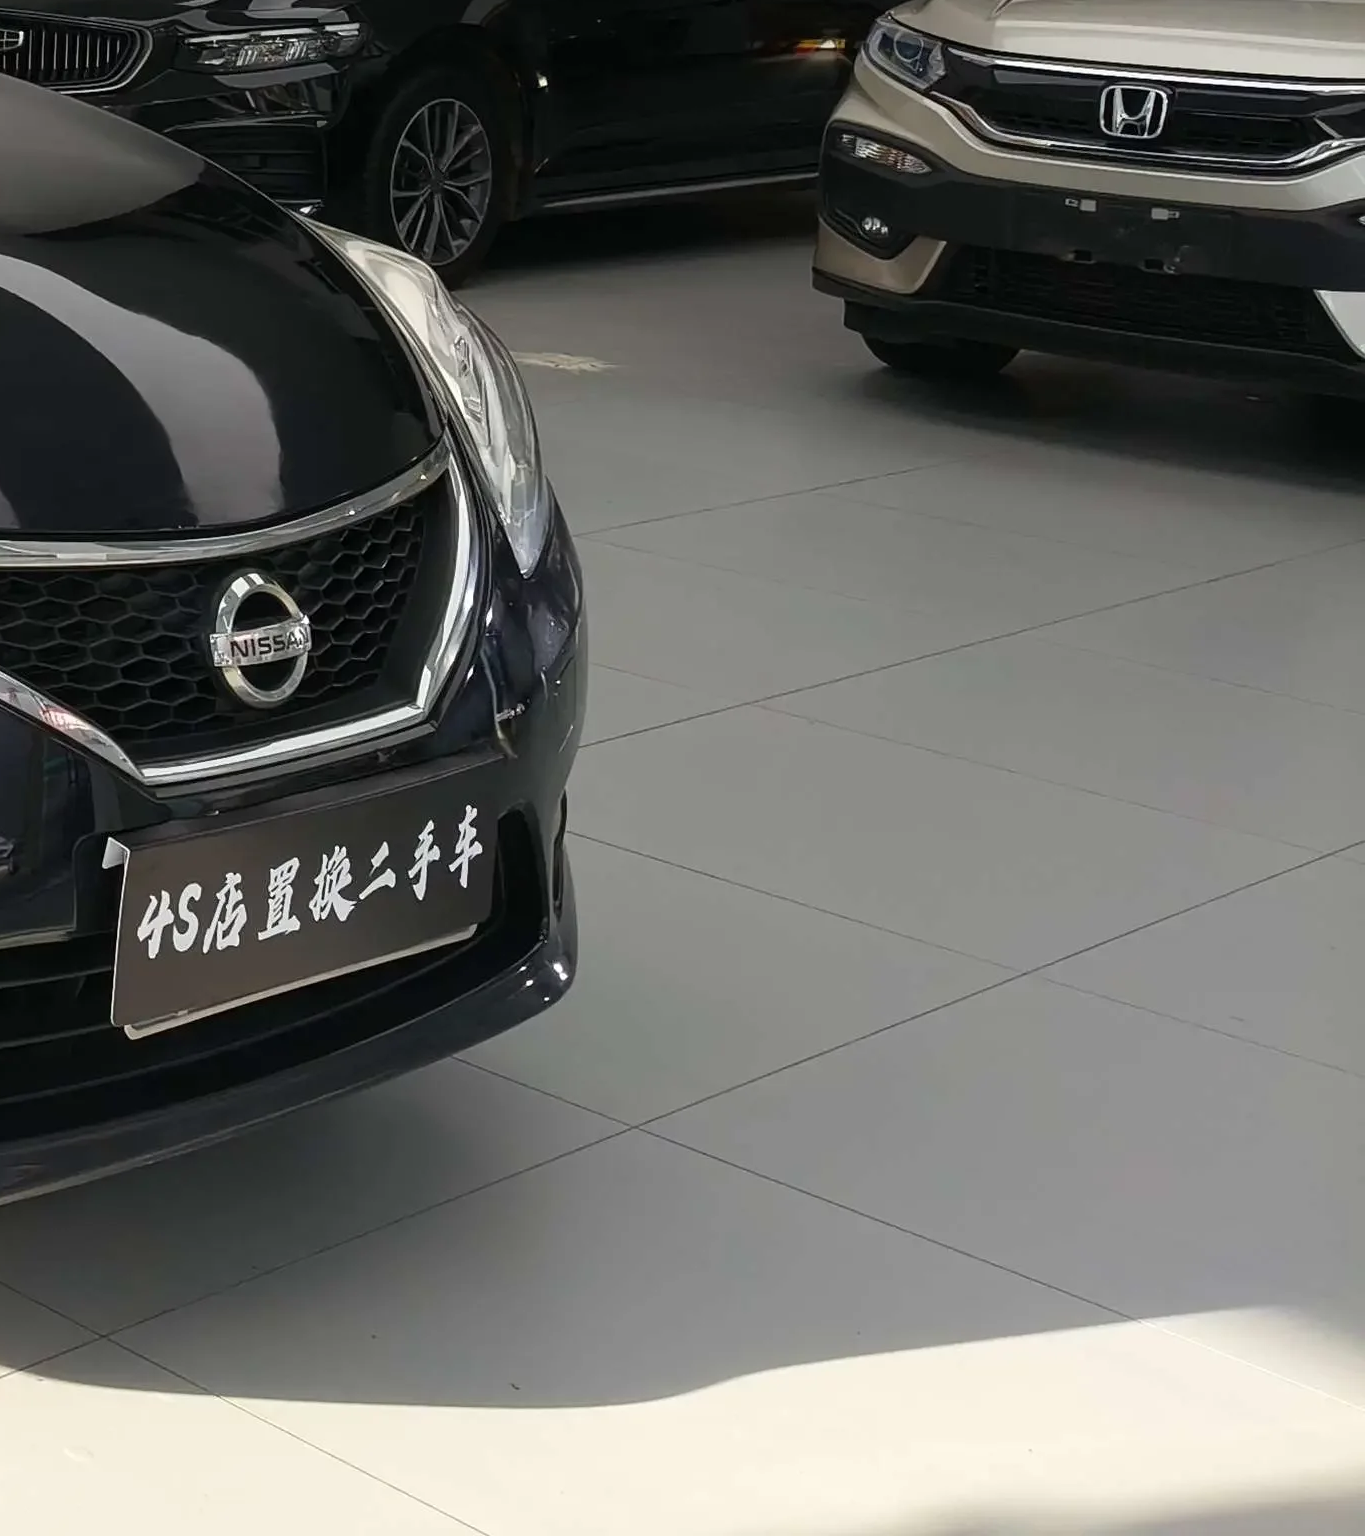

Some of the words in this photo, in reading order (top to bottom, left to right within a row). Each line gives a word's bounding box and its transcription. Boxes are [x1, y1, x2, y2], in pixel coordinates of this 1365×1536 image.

[230, 627, 309, 657] NISSAN
[138, 805, 483, 959] 4S店置换二手车
